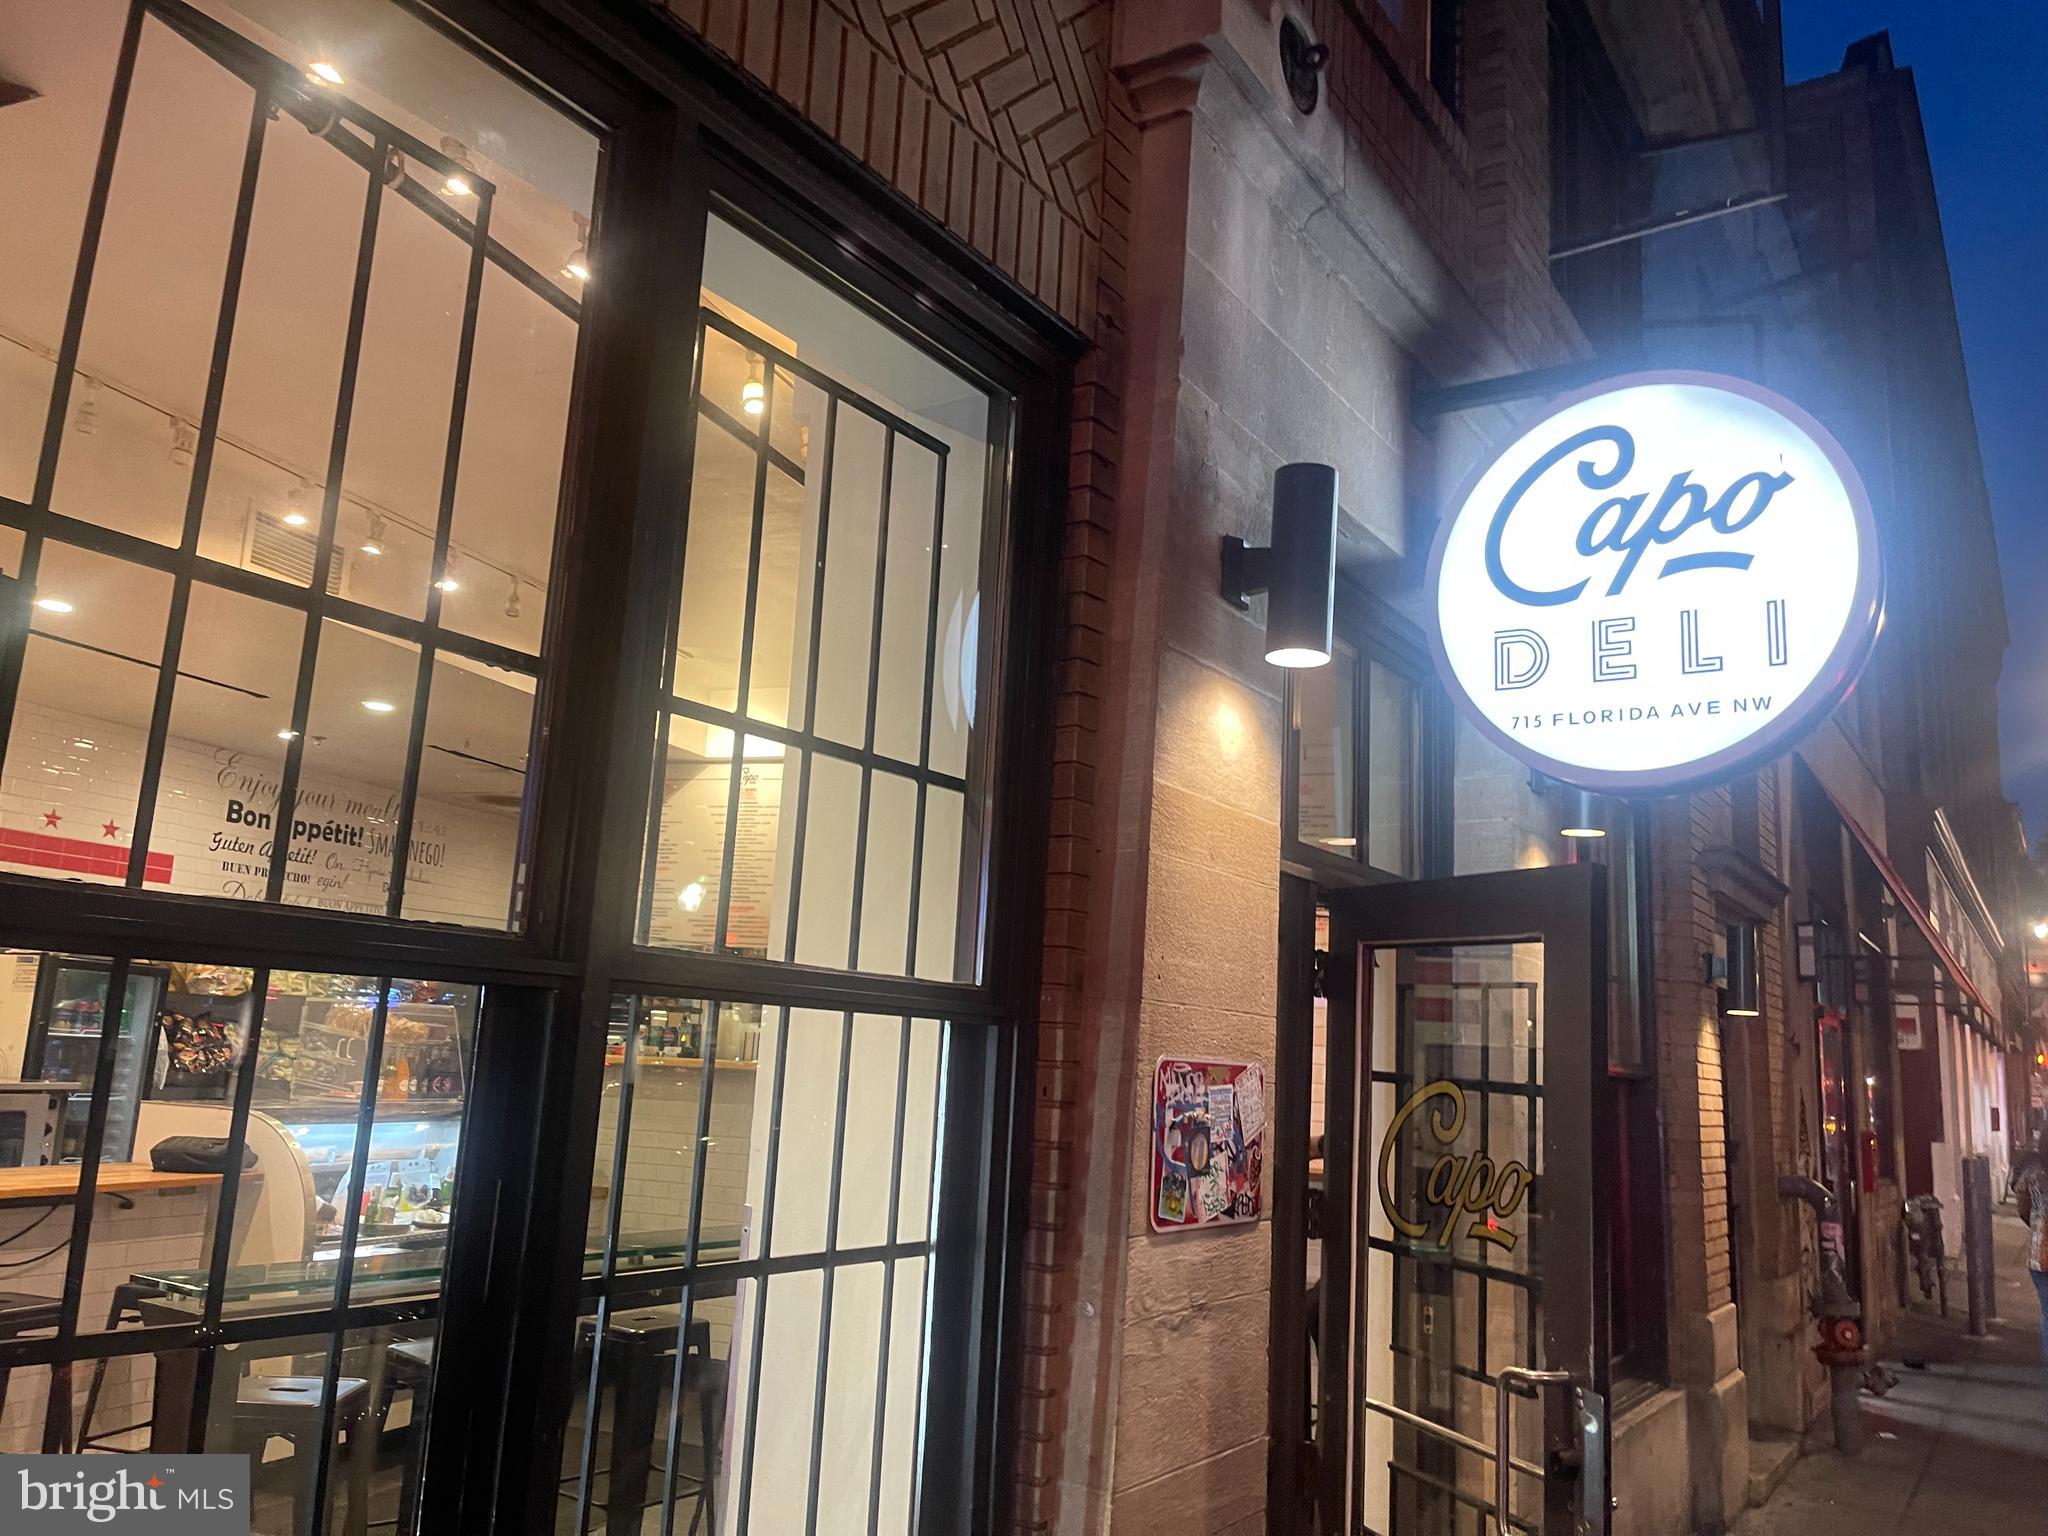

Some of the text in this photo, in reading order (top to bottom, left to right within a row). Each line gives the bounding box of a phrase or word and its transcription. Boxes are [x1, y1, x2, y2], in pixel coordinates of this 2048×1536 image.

[1485, 425, 1795, 607] Capo
[1494, 599, 1788, 691] DELI
[1511, 696, 1773, 730] 715 FLORIDA AVE NW
[209, 831, 317, 865] Guten Aetit!
[226, 799, 364, 848] Bon ppétit!
[222, 861, 311, 885] BUEN PRCHO!
[1378, 1080, 1534, 1249] Capo
